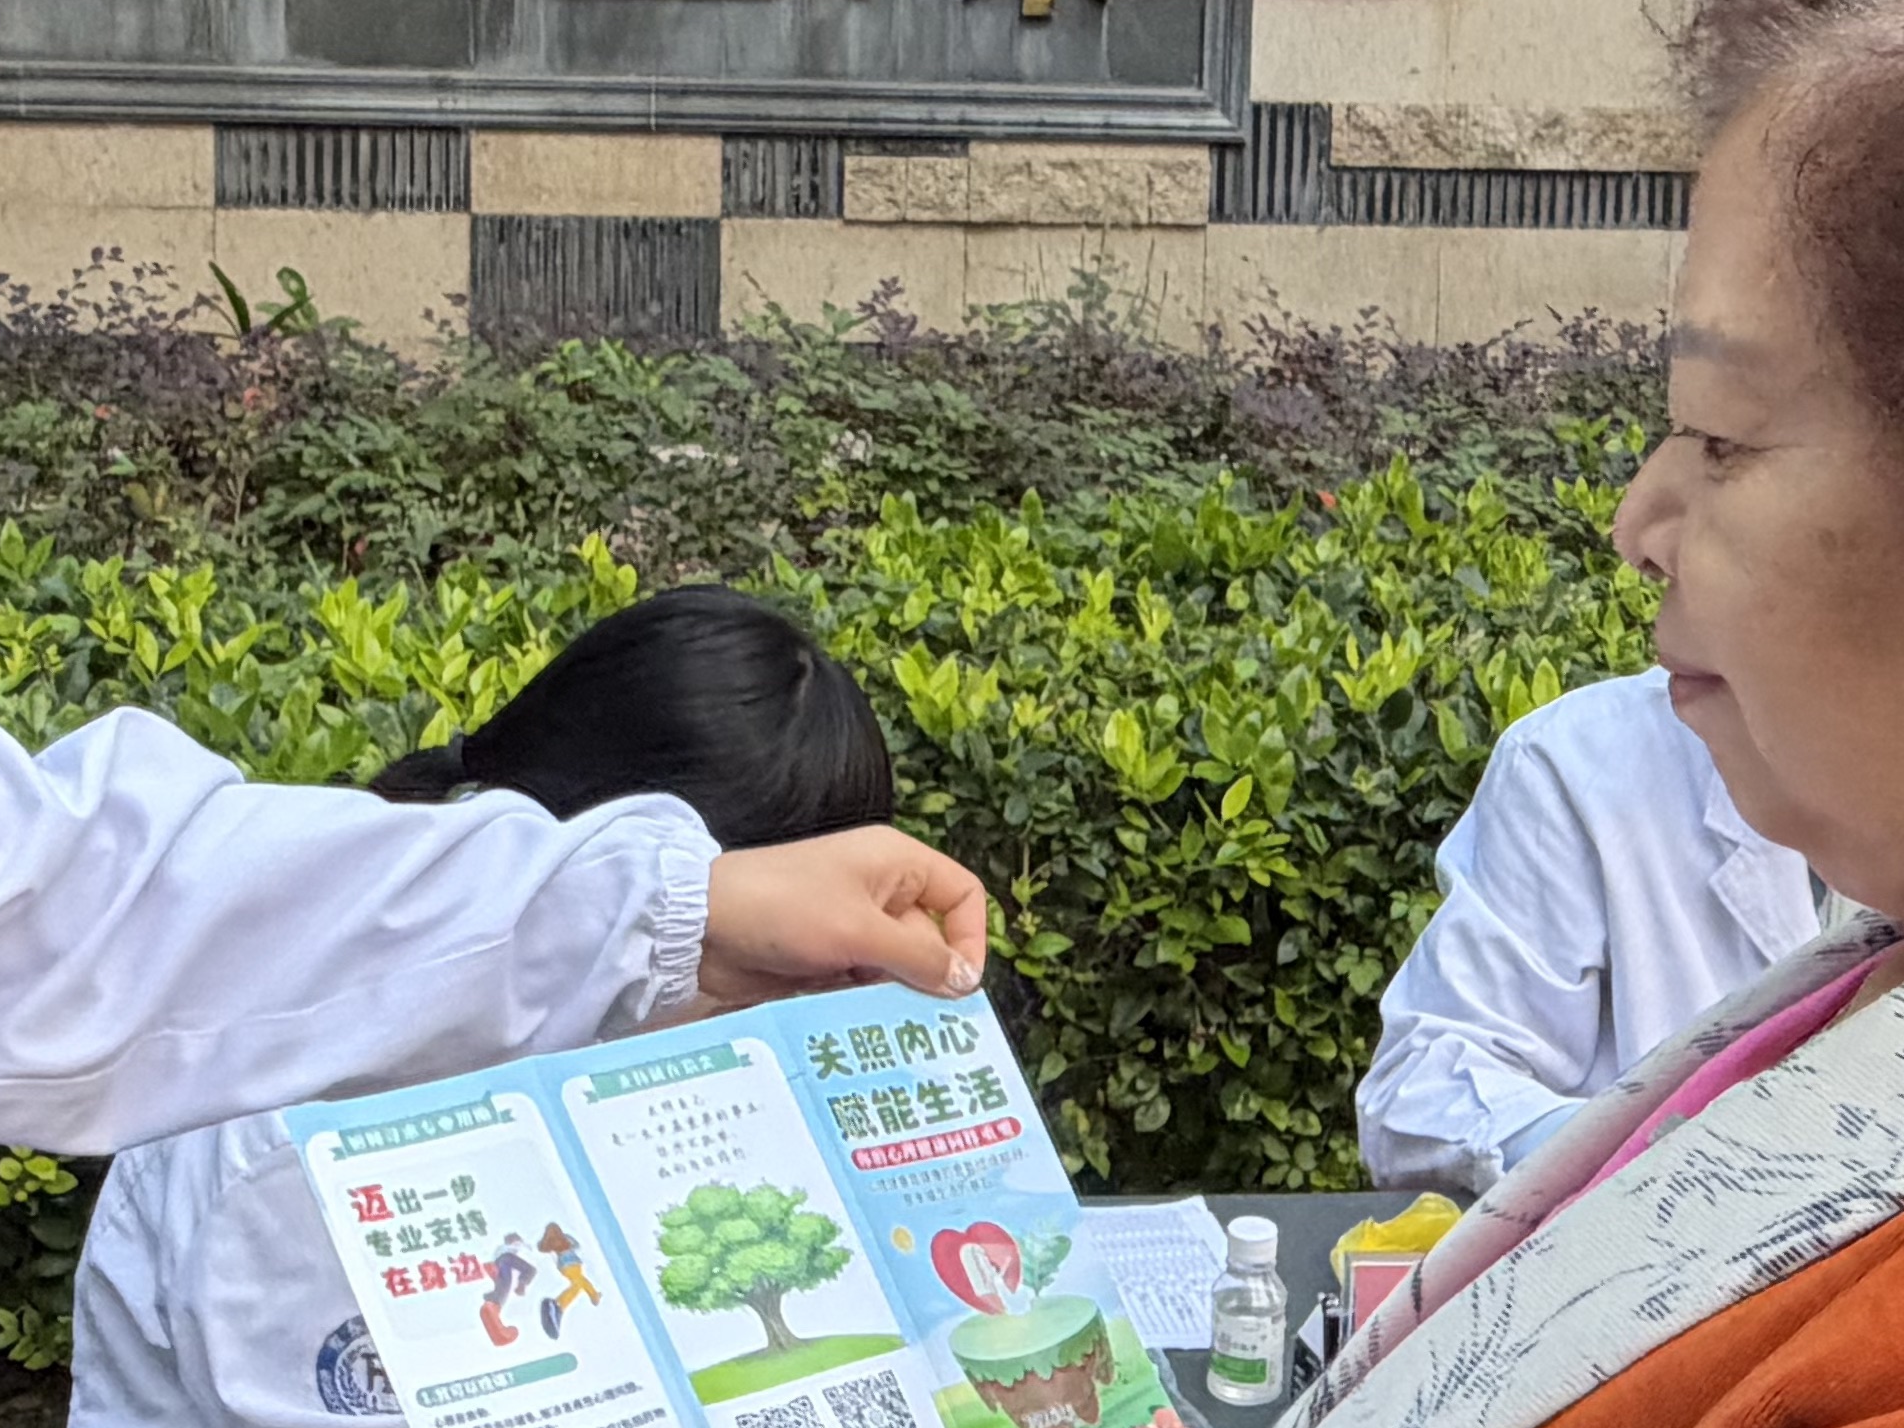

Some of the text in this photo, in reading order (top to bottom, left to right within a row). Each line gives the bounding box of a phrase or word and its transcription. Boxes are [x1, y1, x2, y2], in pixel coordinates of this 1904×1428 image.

[805, 1013, 981, 1083] 关照内心
[830, 1064, 1010, 1143] 赋能生活
[347, 1174, 477, 1224] 迈出一步
[364, 1209, 489, 1258] 专业支持
[379, 1253, 486, 1299] 在身边
